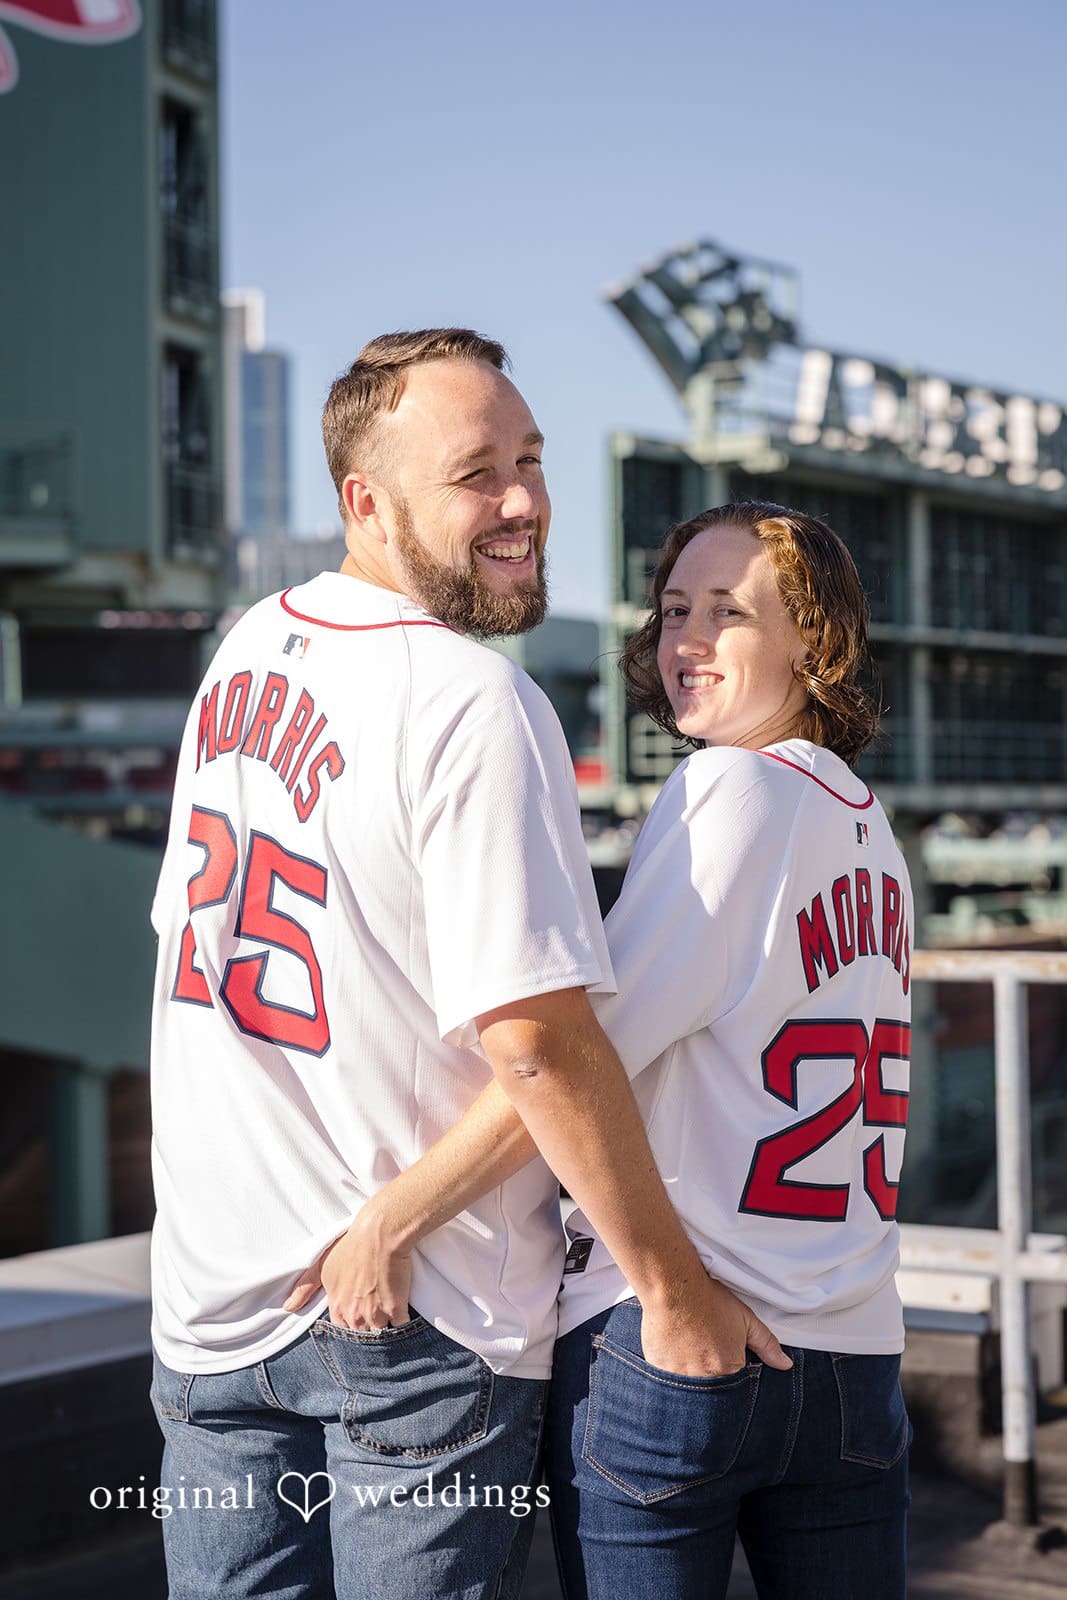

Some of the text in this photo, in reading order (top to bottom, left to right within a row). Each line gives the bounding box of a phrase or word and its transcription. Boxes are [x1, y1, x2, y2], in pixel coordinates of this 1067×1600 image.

[195, 669, 346, 824] MORRIS
[171, 803, 332, 1058] 25
[738, 1018, 912, 1222] 25
